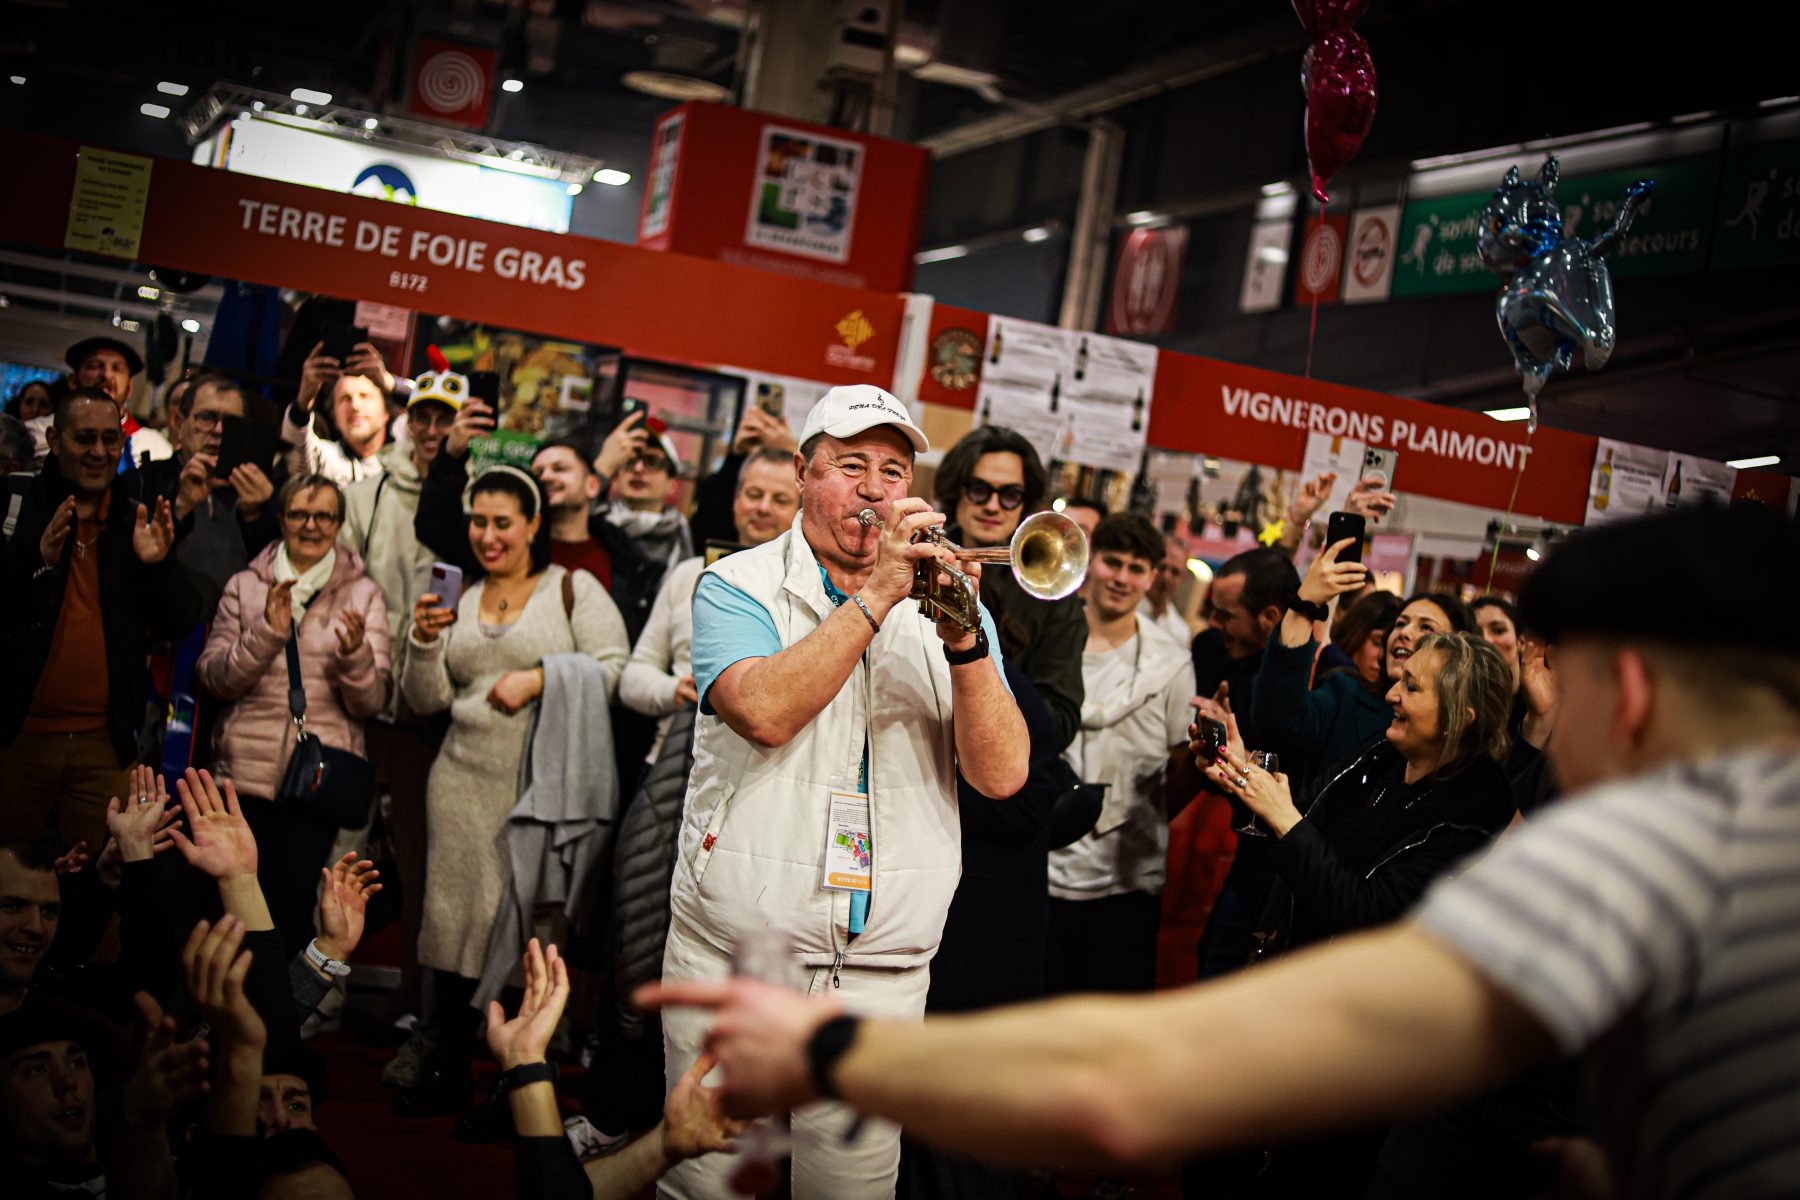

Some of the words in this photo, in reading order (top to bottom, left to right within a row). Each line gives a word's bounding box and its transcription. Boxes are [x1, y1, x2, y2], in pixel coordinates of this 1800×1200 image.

[239, 199, 347, 247] TERRE
[355, 220, 402, 257] DE
[409, 230, 487, 273] FOIE
[494, 247, 586, 291] GRAS
[1618, 227, 1699, 257] secours
[388, 270, 429, 292] B172
[1221, 384, 1385, 444] VIGNERONS
[1390, 419, 1533, 472] PLAIMONT
